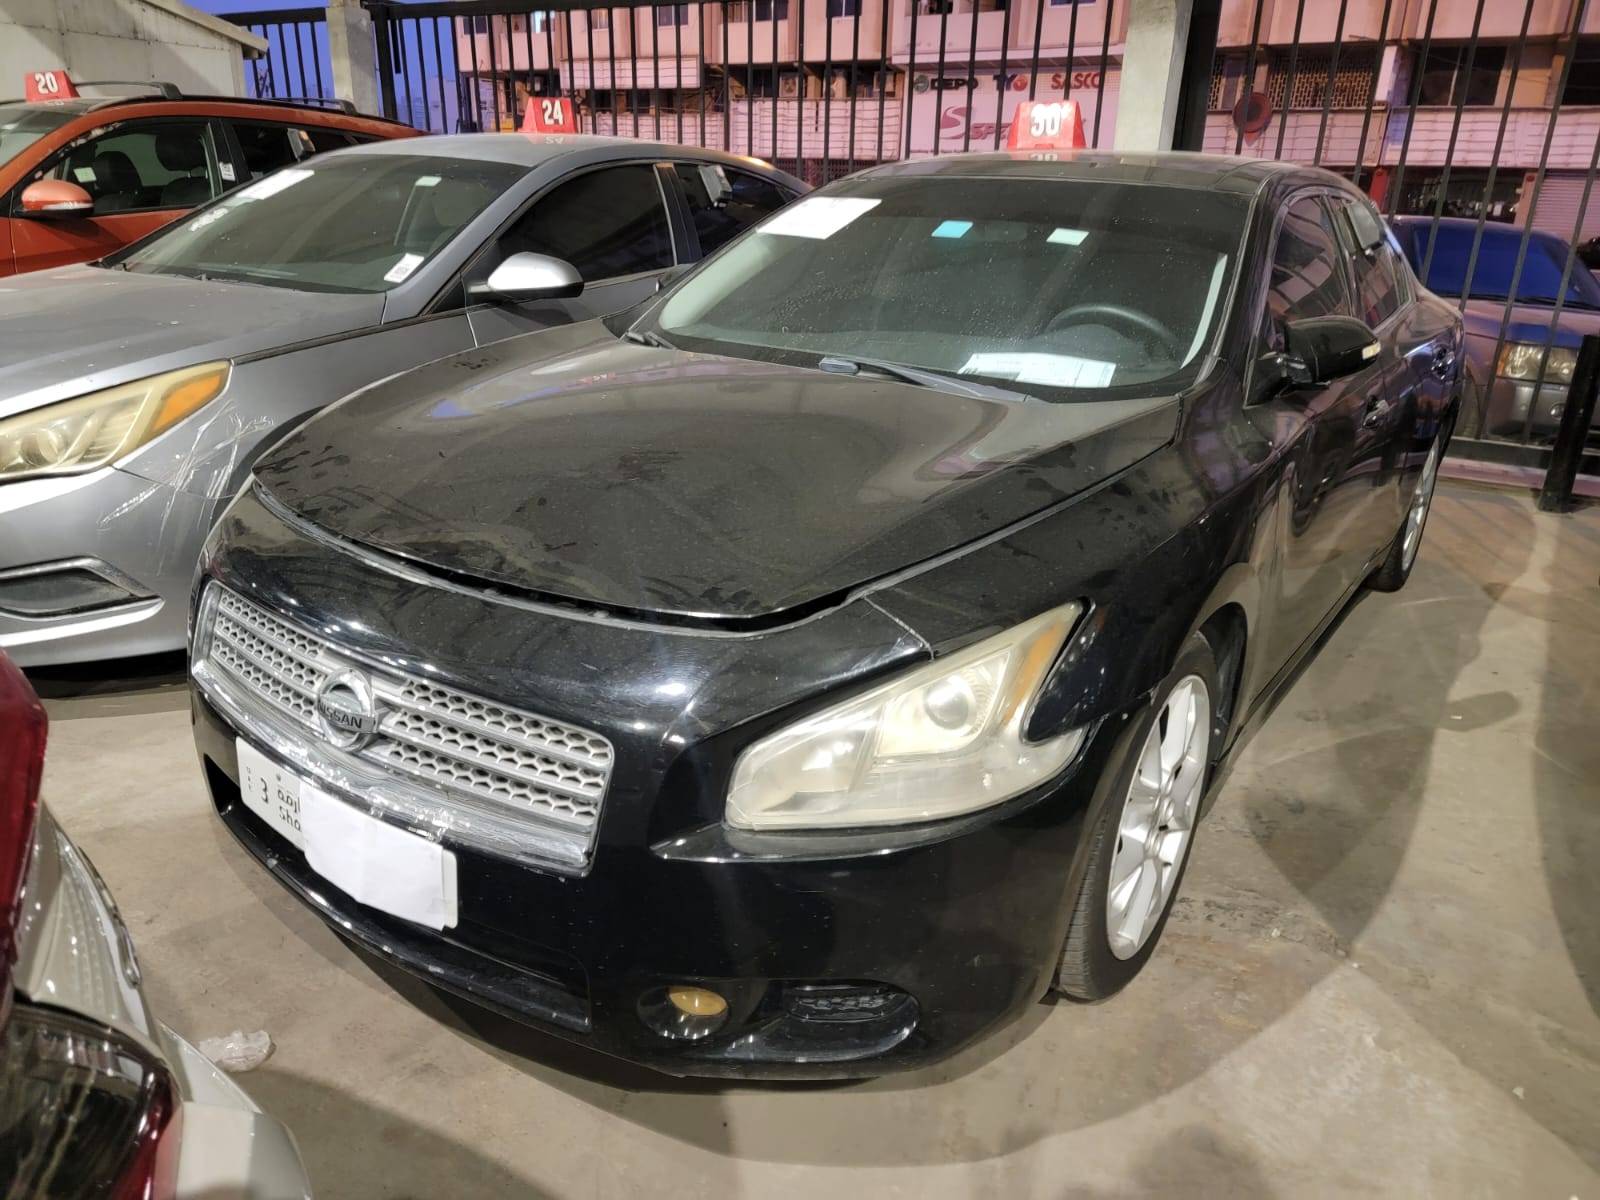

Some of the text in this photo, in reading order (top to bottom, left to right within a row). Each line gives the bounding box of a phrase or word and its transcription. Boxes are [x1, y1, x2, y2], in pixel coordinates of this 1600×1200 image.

[34, 71, 58, 94] 20
[542, 99, 564, 126] 24
[1031, 103, 1061, 137] 30
[319, 699, 362, 728] NISSAN
